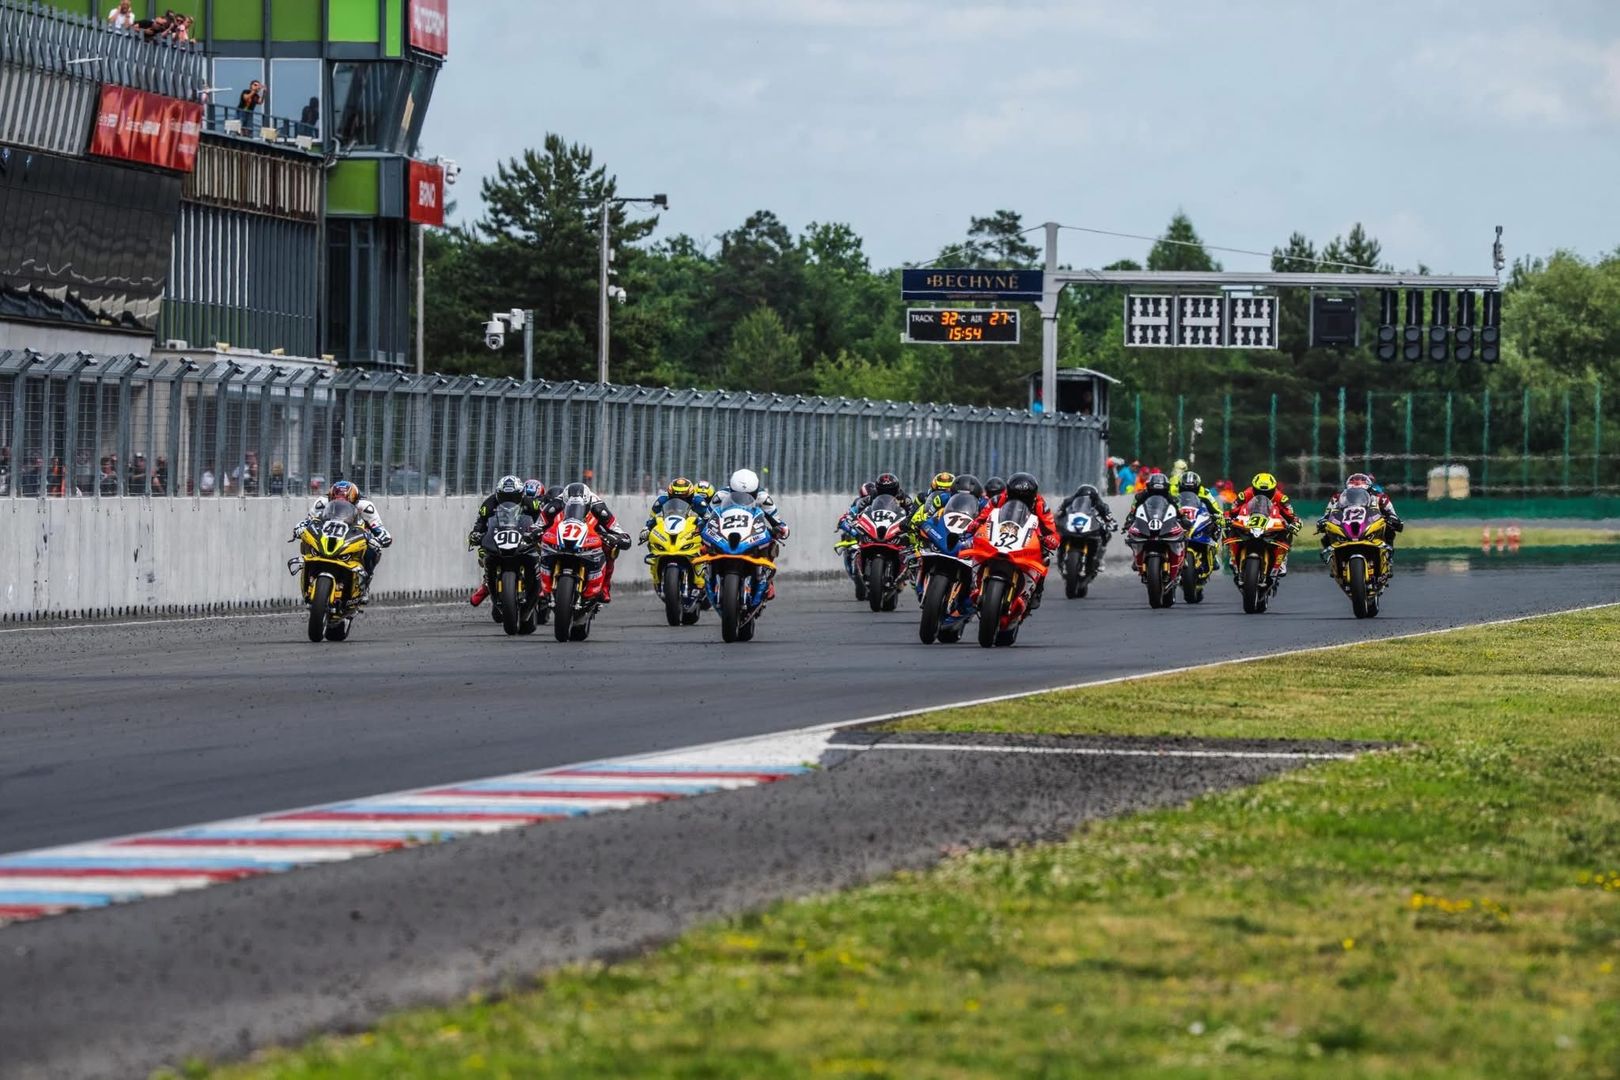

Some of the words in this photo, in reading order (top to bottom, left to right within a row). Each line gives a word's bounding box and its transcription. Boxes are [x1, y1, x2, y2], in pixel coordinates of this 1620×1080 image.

[911, 314, 934, 323] TRACK
[970, 315, 982, 323] AIR
[949, 327, 982, 341] 15:54
[1343, 508, 1365, 521] 12
[323, 521, 346, 537] 40
[668, 516, 682, 531] 7
[1149, 519, 1161, 529] 41
[497, 531, 520, 545] 90
[562, 524, 582, 538] 37
[995, 532, 1018, 549] 32
